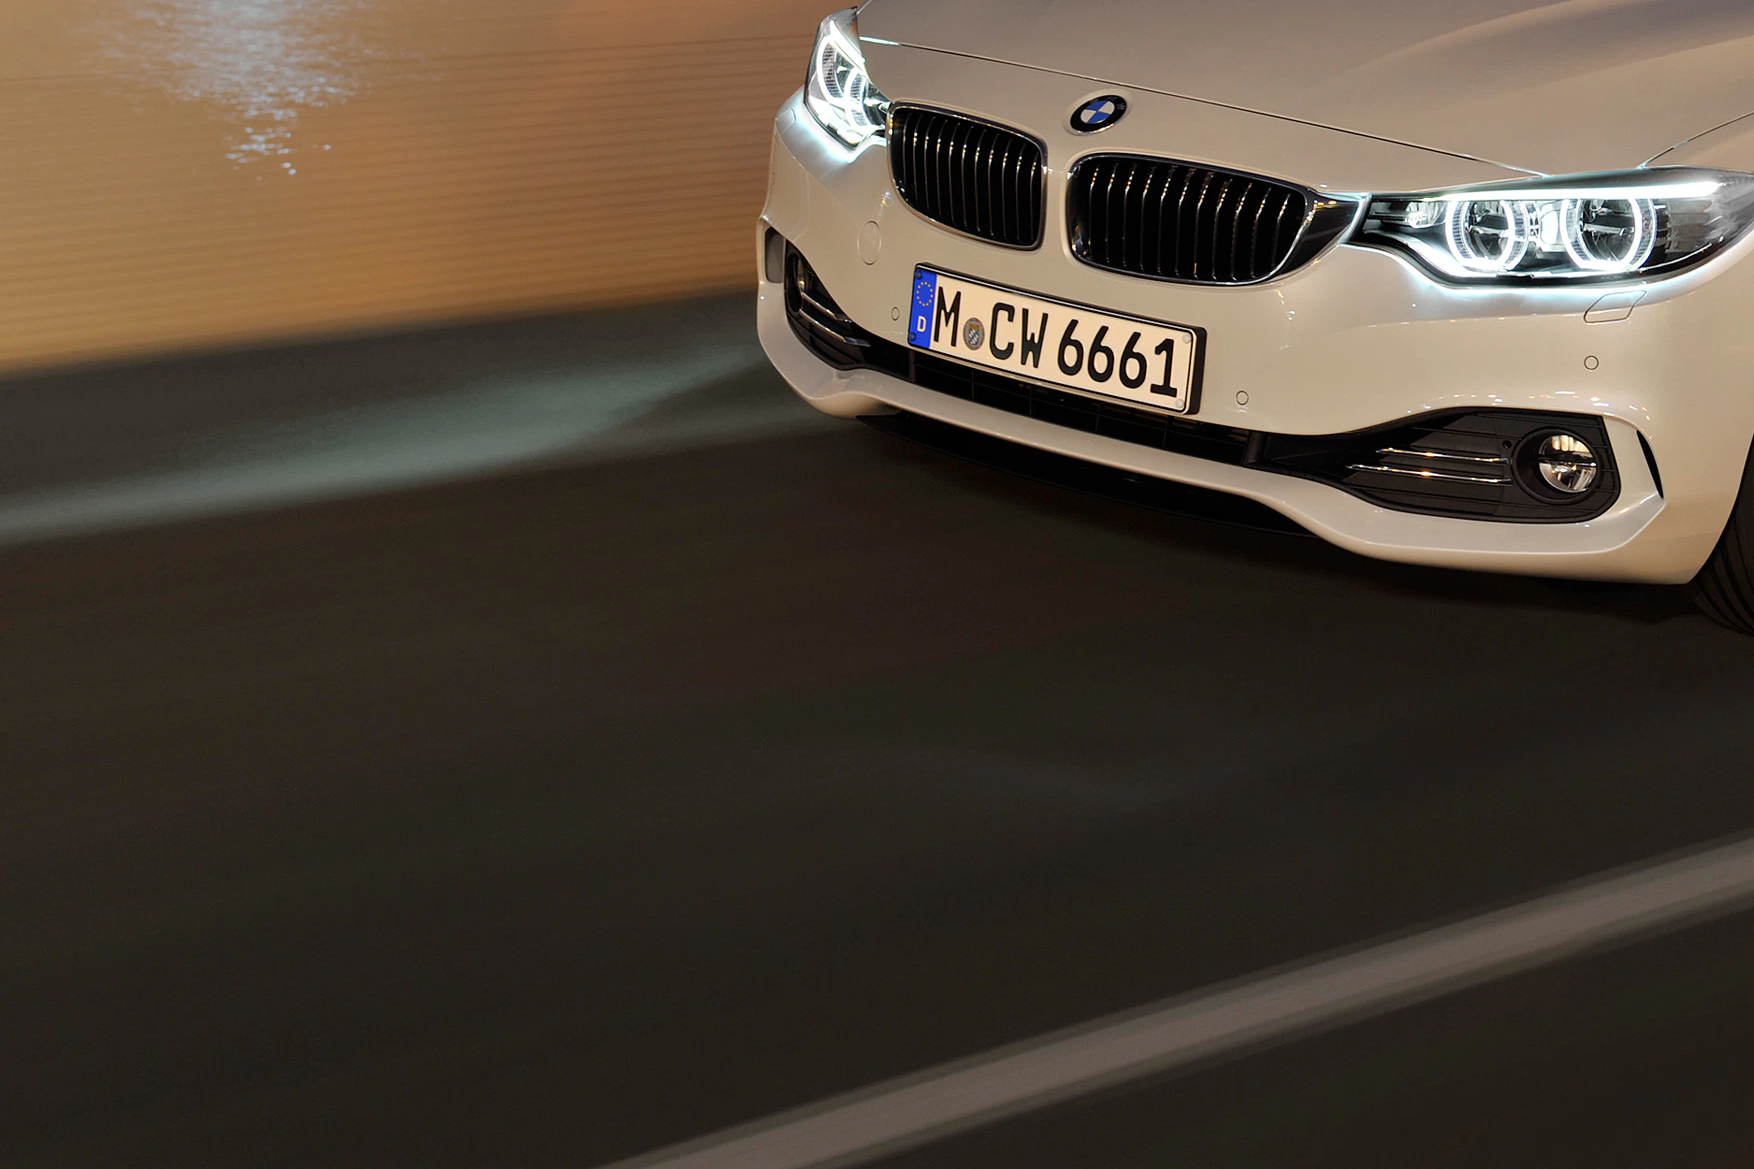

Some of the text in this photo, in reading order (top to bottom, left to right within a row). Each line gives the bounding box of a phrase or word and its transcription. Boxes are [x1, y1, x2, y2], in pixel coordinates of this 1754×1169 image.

[917, 315, 927, 332] D
[933, 286, 962, 348] M
[989, 302, 1049, 369] CW
[1057, 318, 1178, 398] 6661
